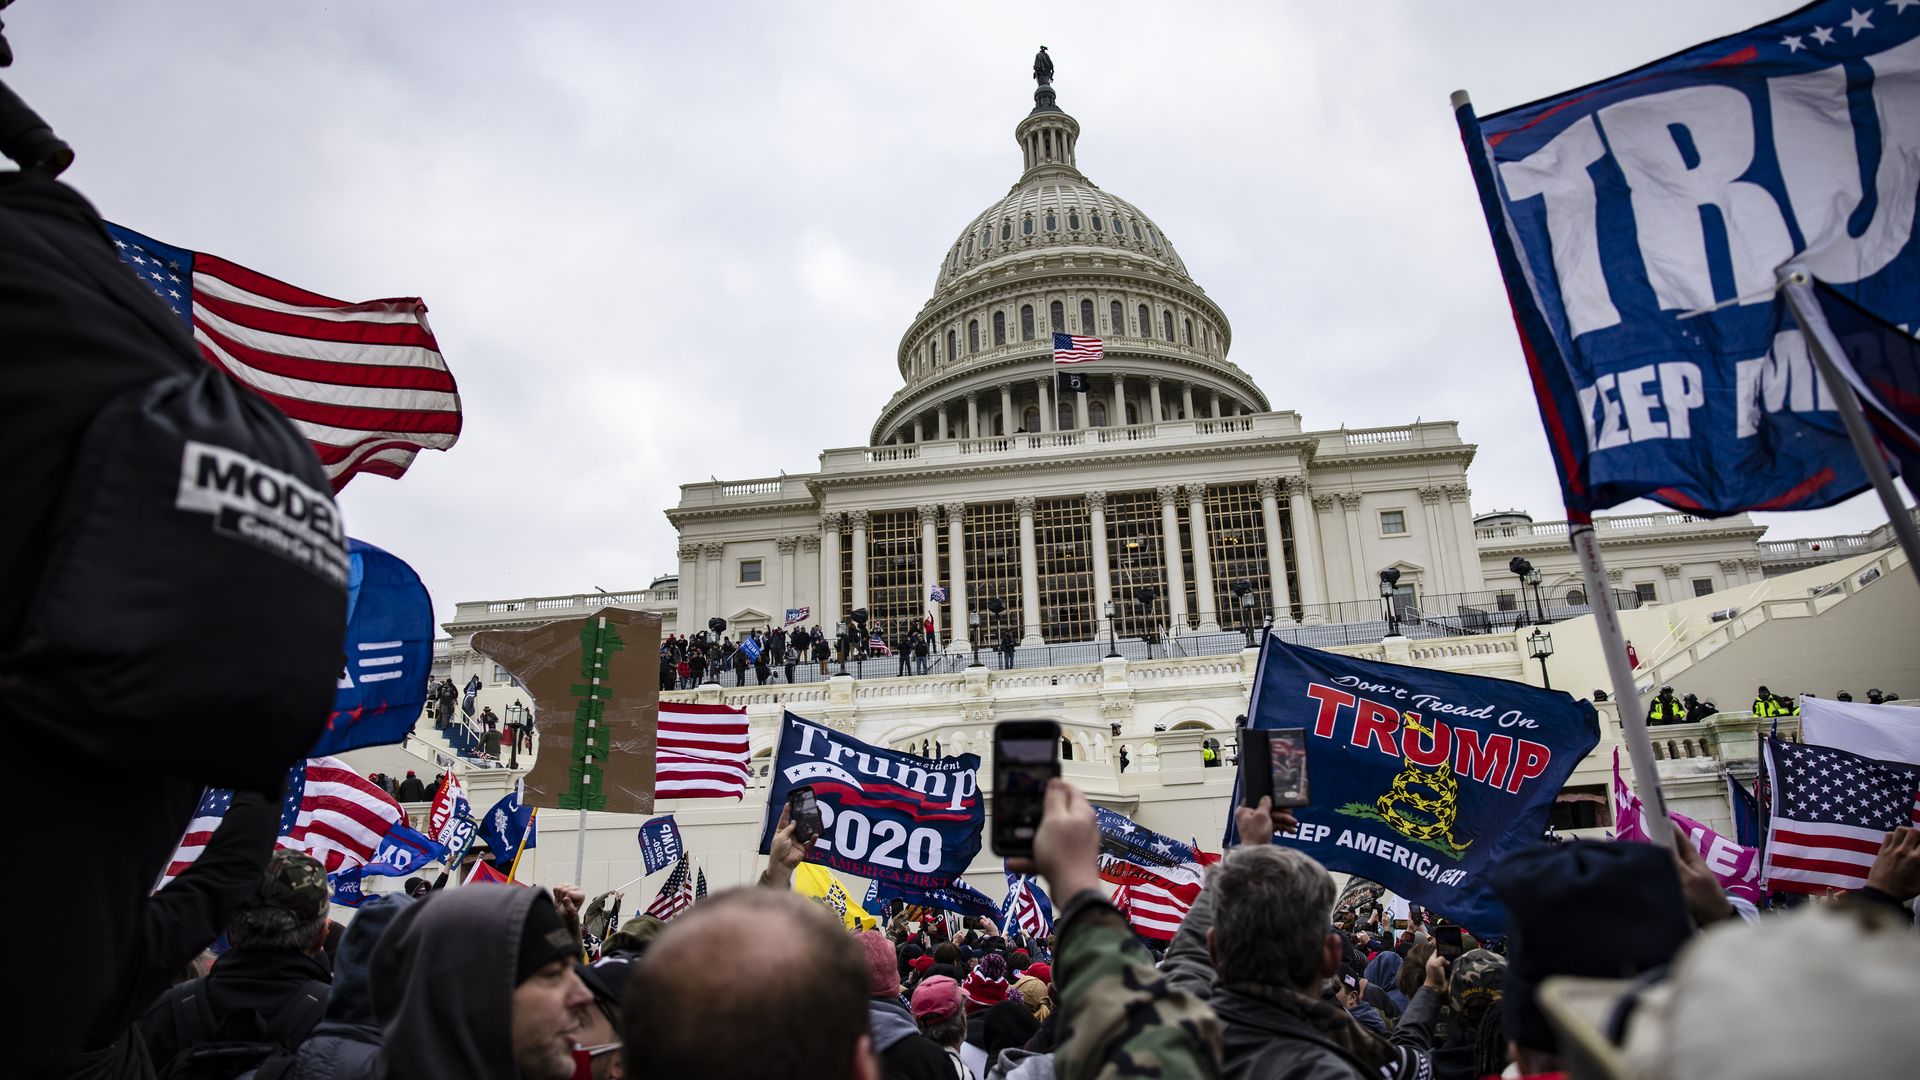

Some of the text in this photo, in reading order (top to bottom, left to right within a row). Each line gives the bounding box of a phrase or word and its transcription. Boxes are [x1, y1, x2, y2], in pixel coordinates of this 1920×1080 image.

[1330, 675, 1540, 730] Don't Tread On
[791, 719, 977, 811] Trump
[1306, 682, 1552, 795] TRUMP
[814, 799, 943, 874] 2020
[1335, 828, 1440, 882] AMERICA
[827, 853, 900, 881] AMERICA
[903, 871, 950, 890] FIRST
